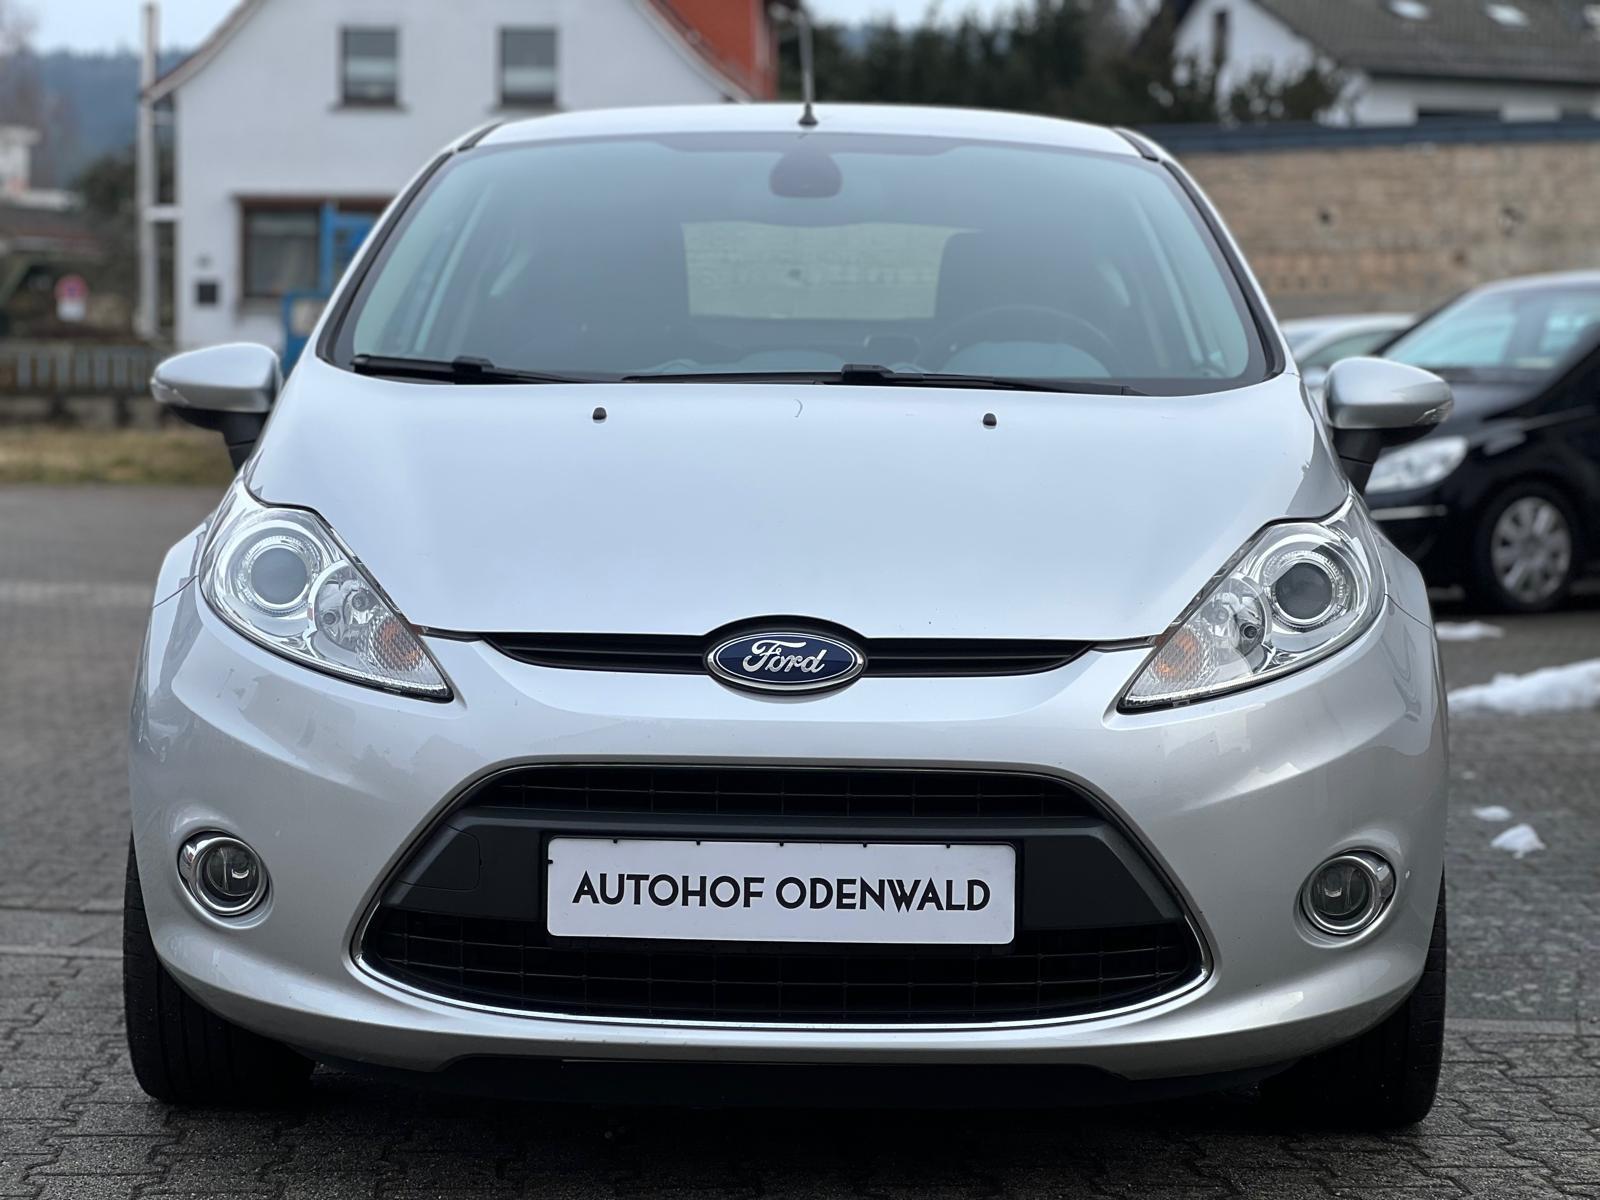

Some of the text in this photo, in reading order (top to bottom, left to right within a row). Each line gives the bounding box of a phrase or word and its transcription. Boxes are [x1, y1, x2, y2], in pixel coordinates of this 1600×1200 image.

[742, 639, 828, 674] Ford
[571, 870, 991, 912] AUTOHOF ODENWALD
